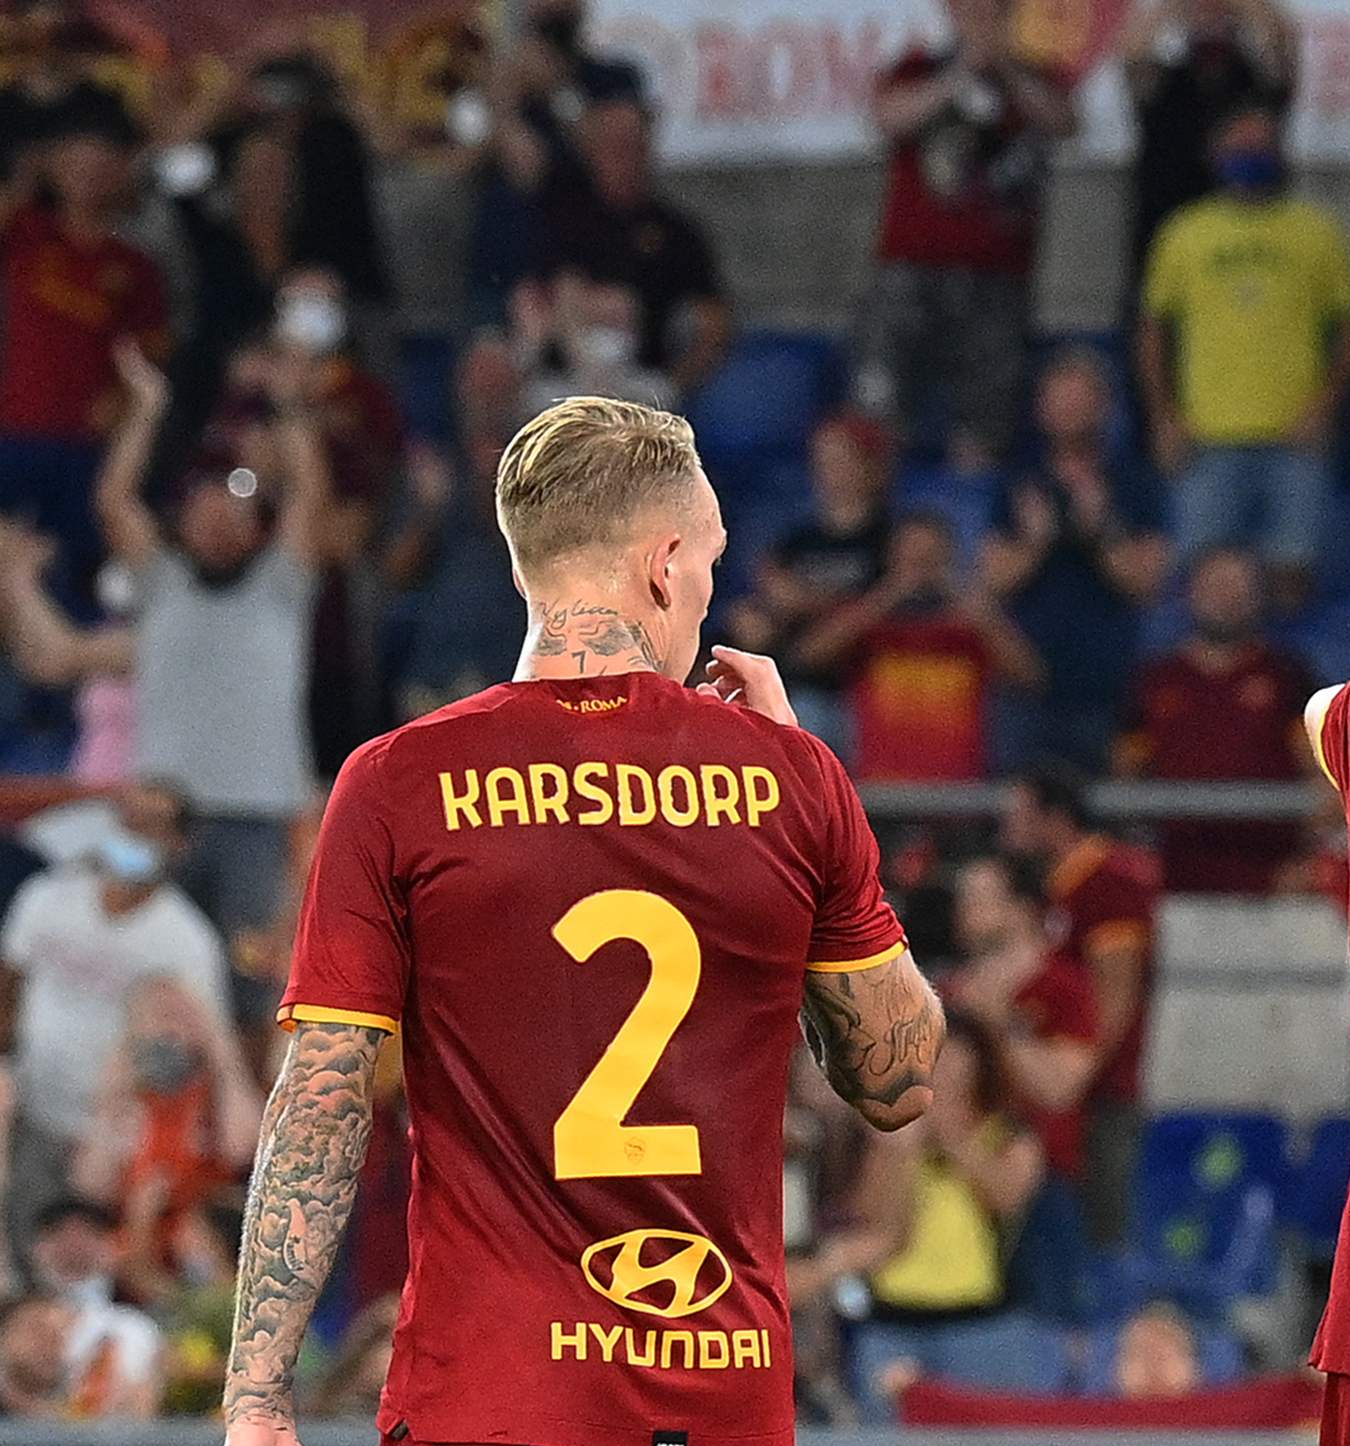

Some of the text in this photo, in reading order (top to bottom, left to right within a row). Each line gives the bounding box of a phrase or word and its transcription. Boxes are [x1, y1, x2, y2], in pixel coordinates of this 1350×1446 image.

[438, 762, 781, 832] KARSDORP
[551, 889, 702, 1180] 2
[550, 1321, 771, 1370] HYUNDAI
